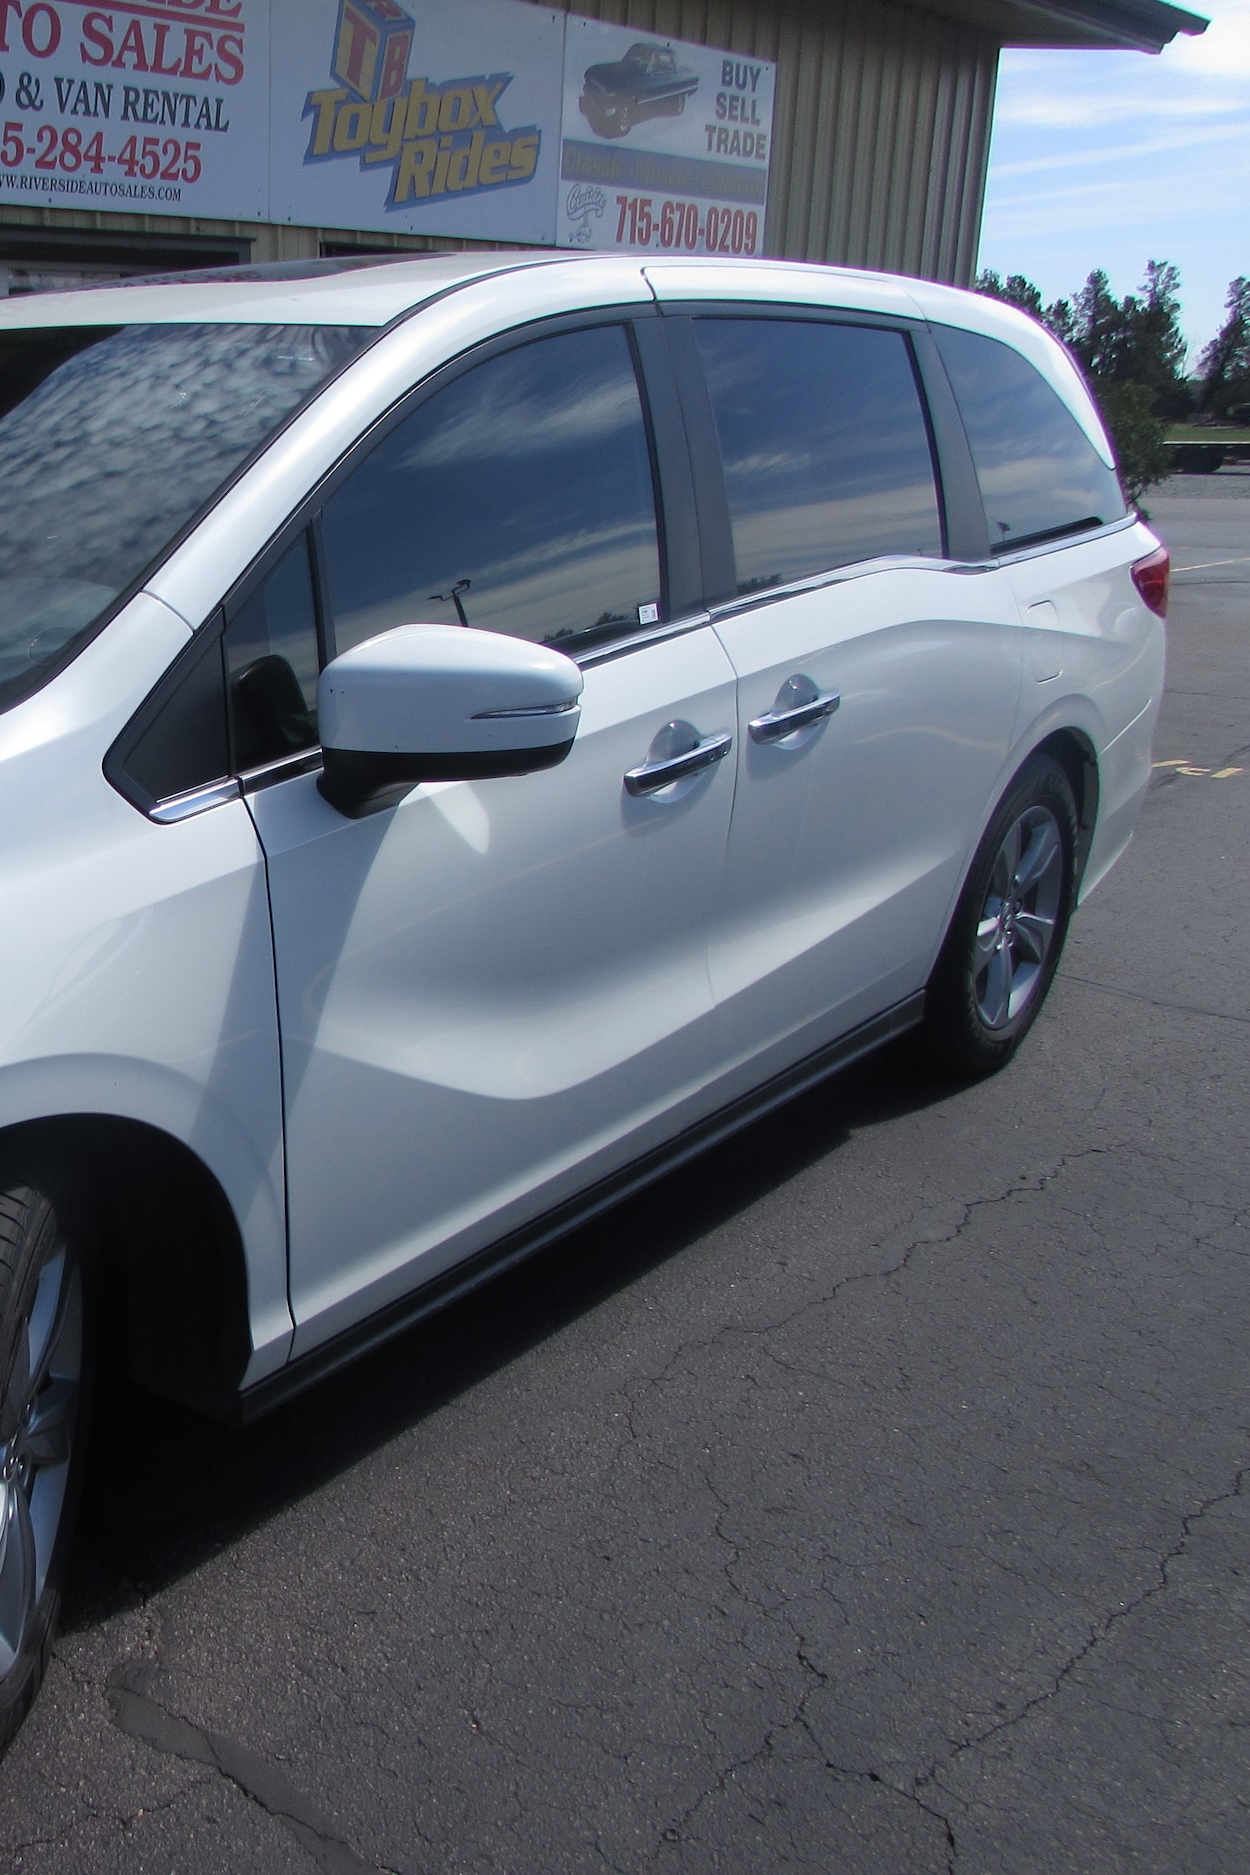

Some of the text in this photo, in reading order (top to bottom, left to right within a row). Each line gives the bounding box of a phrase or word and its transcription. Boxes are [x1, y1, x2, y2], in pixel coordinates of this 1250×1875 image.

[79, 11, 245, 86] SALES
[720, 60, 762, 94] BUY
[14, 71, 45, 112] &
[53, 76, 114, 119] VAN
[121, 85, 231, 133] RENTAL
[308, 79, 505, 165] Toybox
[714, 92, 761, 127] SELL
[393, 129, 540, 204] Rides
[704, 124, 767, 161] TRADE
[615, 195, 759, 256] 715-670-0209
